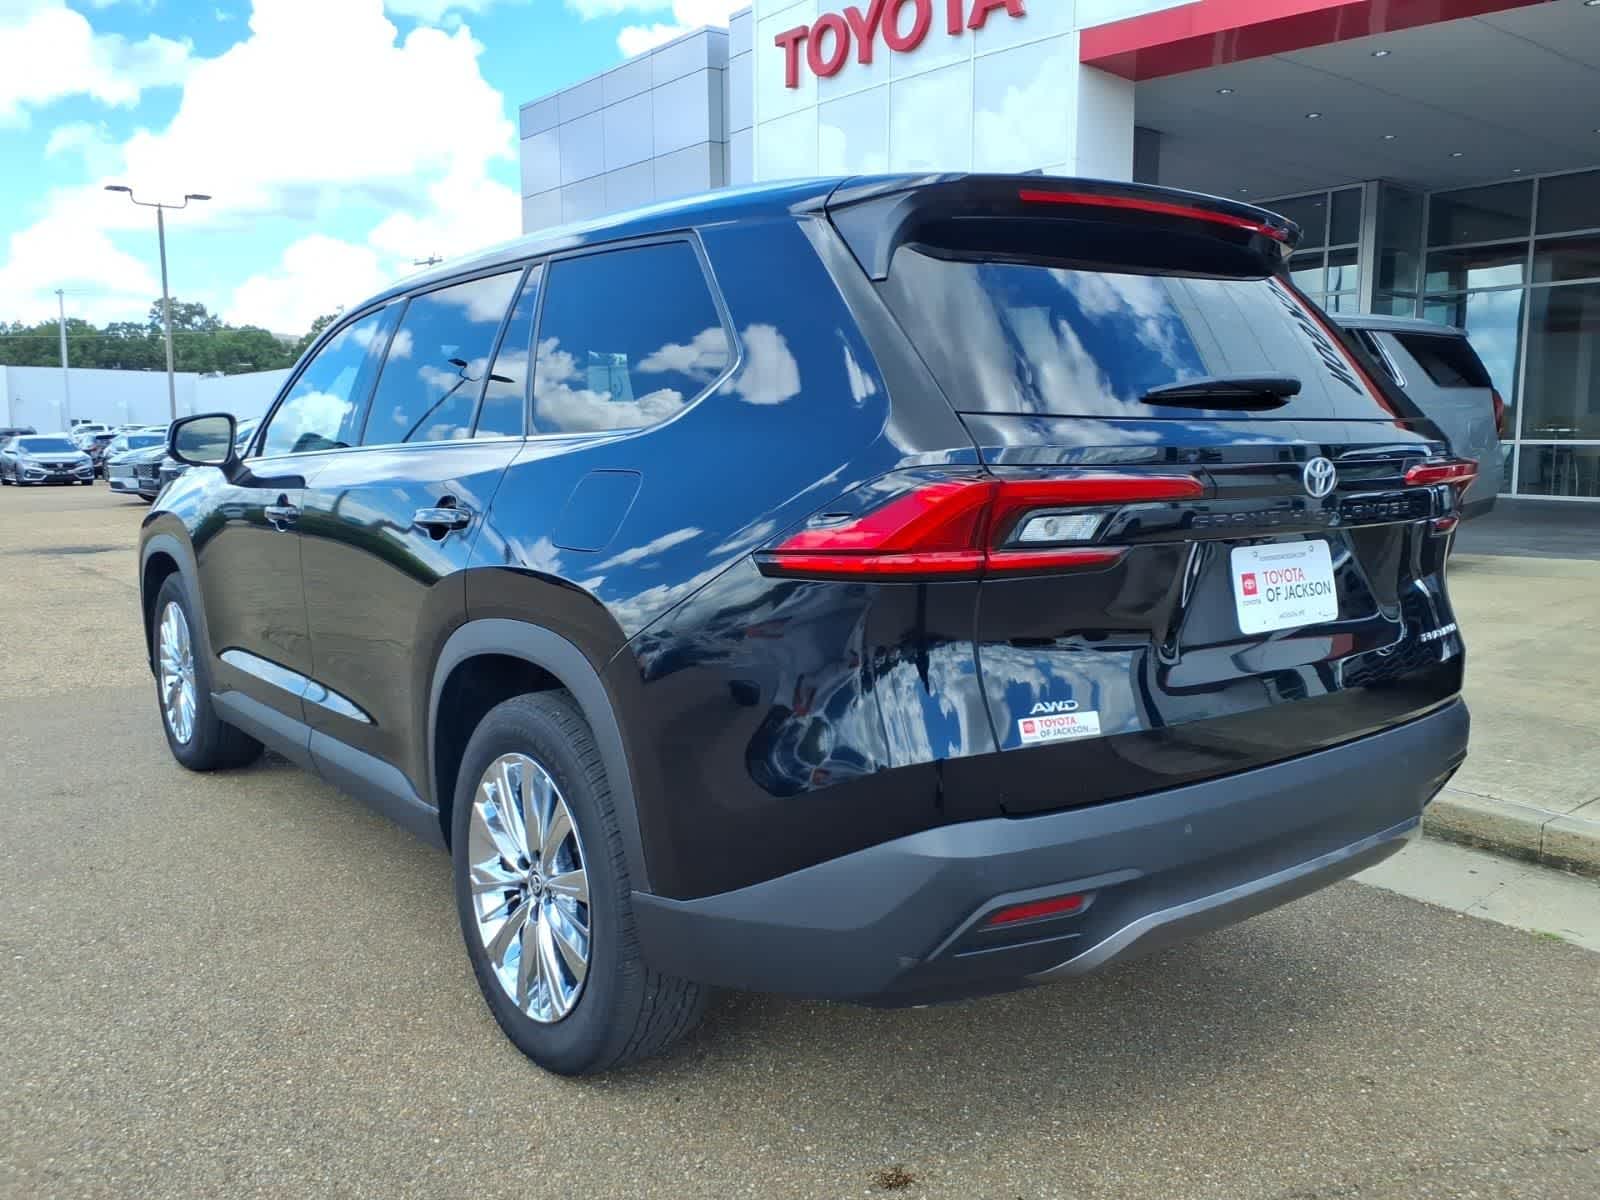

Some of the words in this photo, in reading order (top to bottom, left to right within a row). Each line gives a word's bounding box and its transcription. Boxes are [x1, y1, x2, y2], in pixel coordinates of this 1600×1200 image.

[1263, 567, 1306, 585] TOYOTA
[1265, 586, 1281, 602] OF
[1284, 580, 1332, 601] JACKSON
[1029, 699, 1079, 715] AWD
[1039, 716, 1077, 729] TOYOTA
[1040, 729, 1051, 738] OF
[1053, 725, 1089, 736] JACKSON
